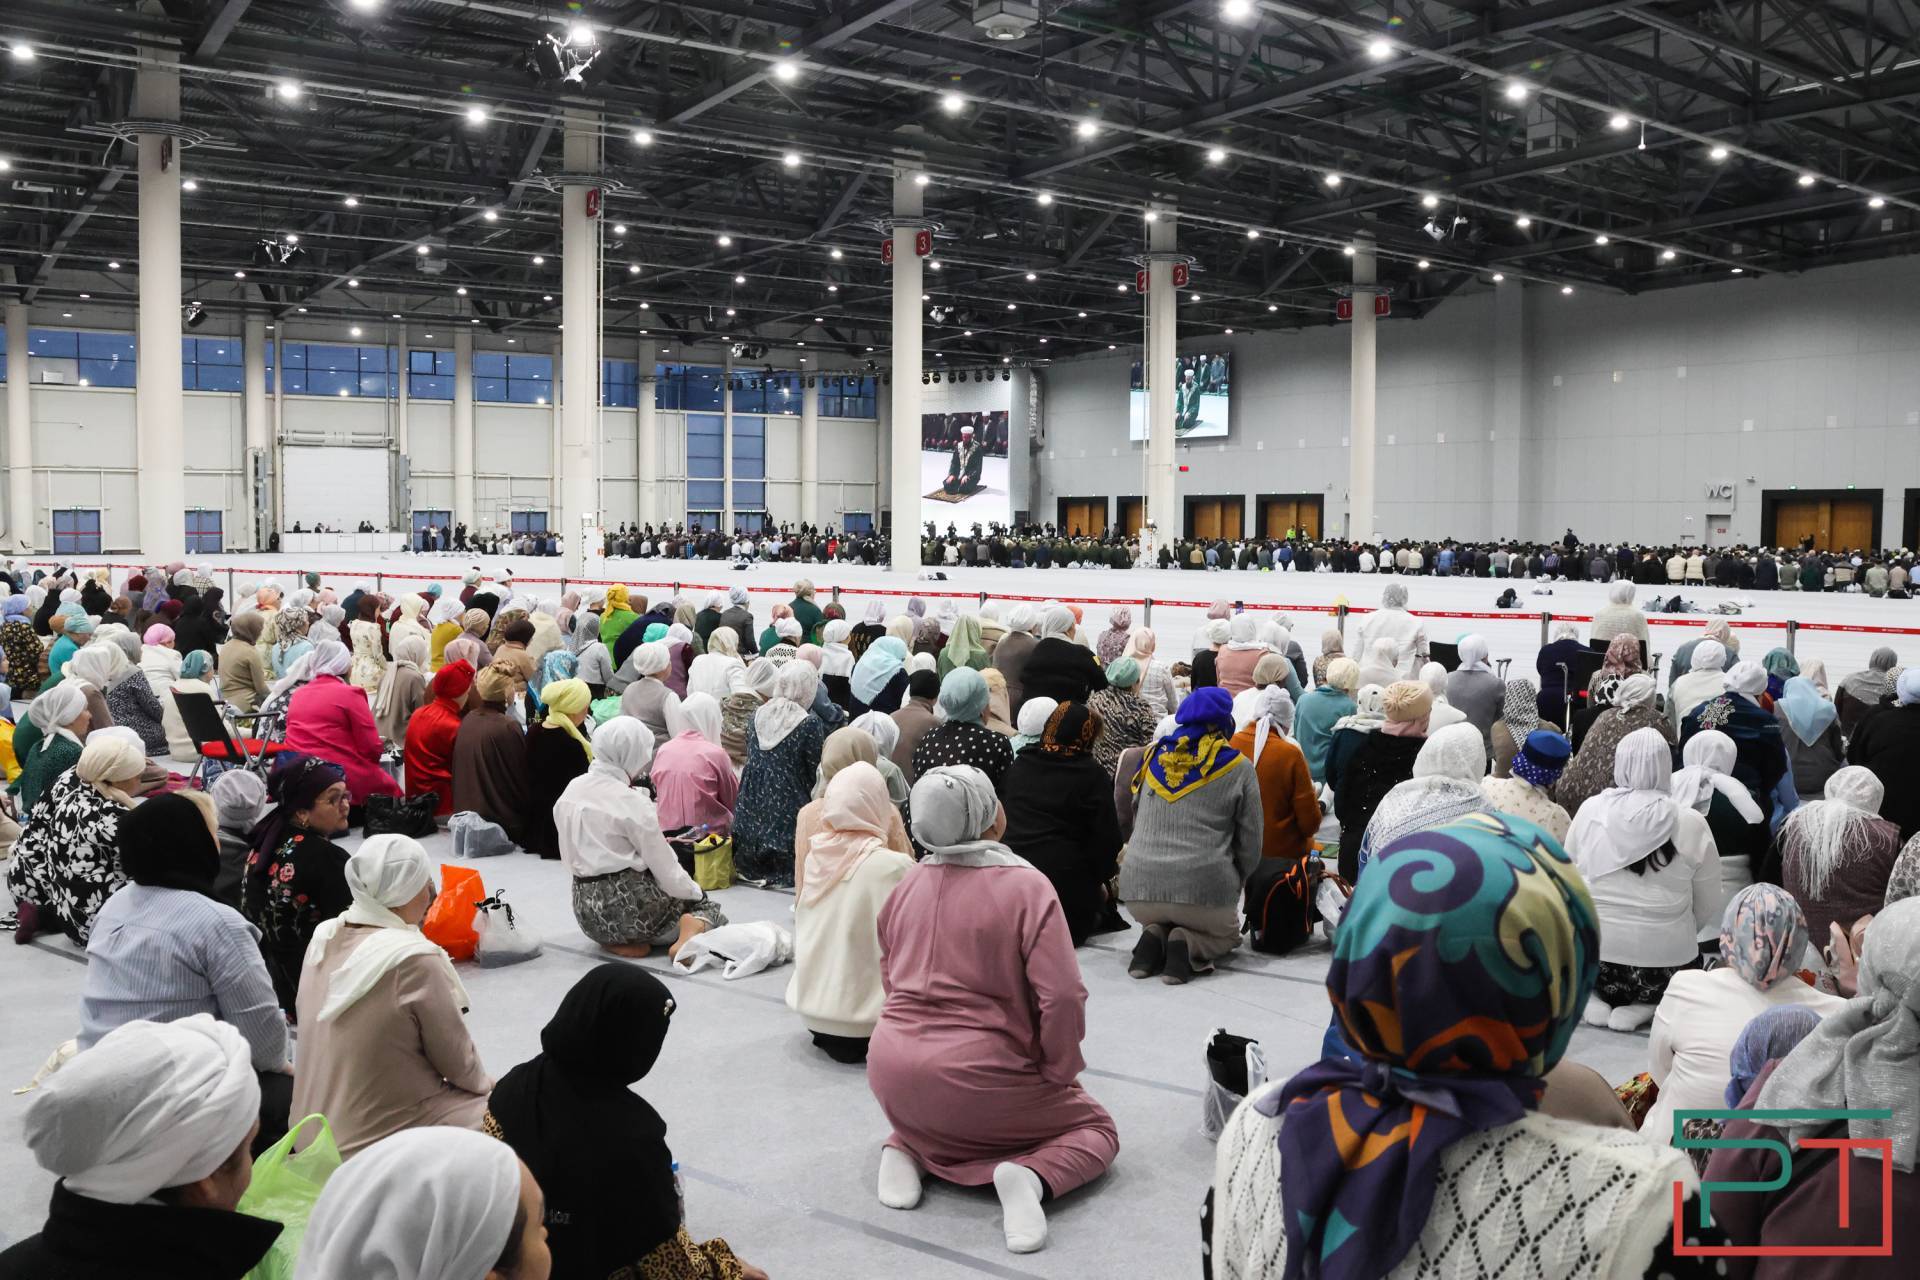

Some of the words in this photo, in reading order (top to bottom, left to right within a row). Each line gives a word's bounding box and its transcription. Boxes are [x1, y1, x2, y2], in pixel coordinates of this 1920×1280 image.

[920, 236, 926, 251] 3
[886, 244, 892, 259] 3
[1177, 269, 1184, 282] 2
[1705, 480, 1732, 498] WC
